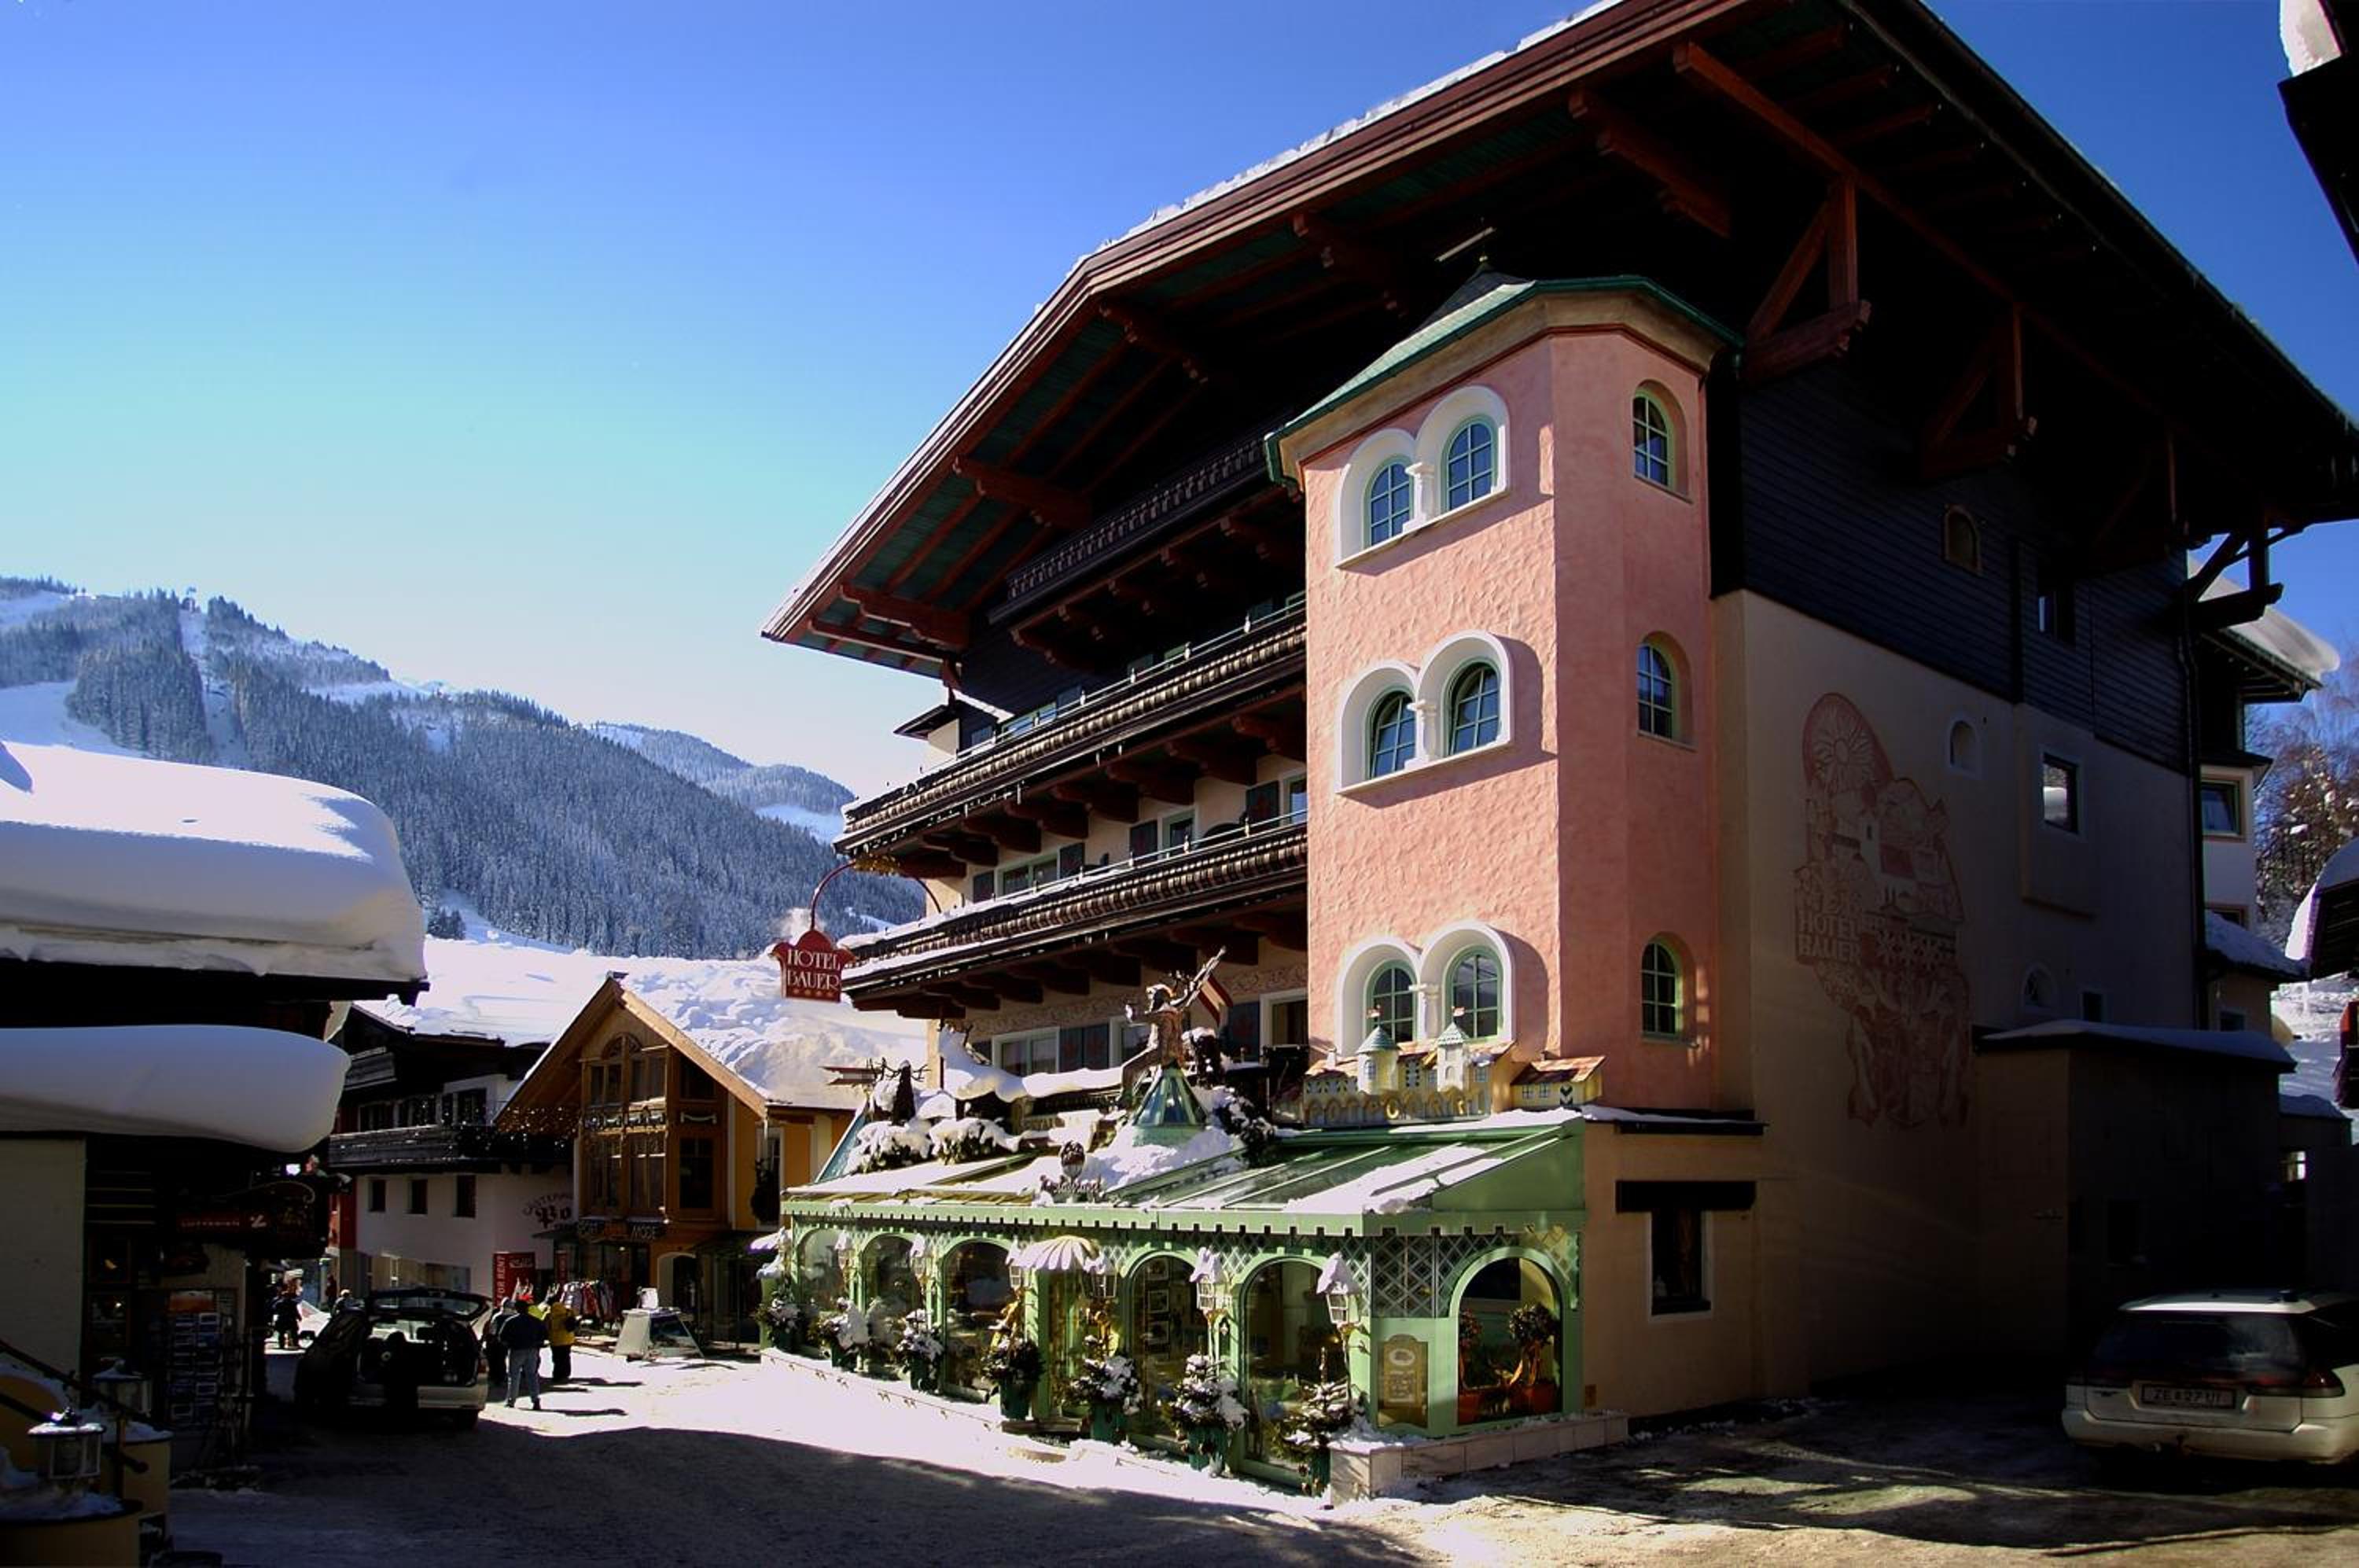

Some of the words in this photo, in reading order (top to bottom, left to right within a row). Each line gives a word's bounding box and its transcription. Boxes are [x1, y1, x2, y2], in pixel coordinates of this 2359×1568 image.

[1800, 909, 1860, 940] HOTEL
[788, 948, 840, 970] HOTEL
[1800, 934, 1860, 964] BAUER
[787, 970, 839, 990] BAUER
